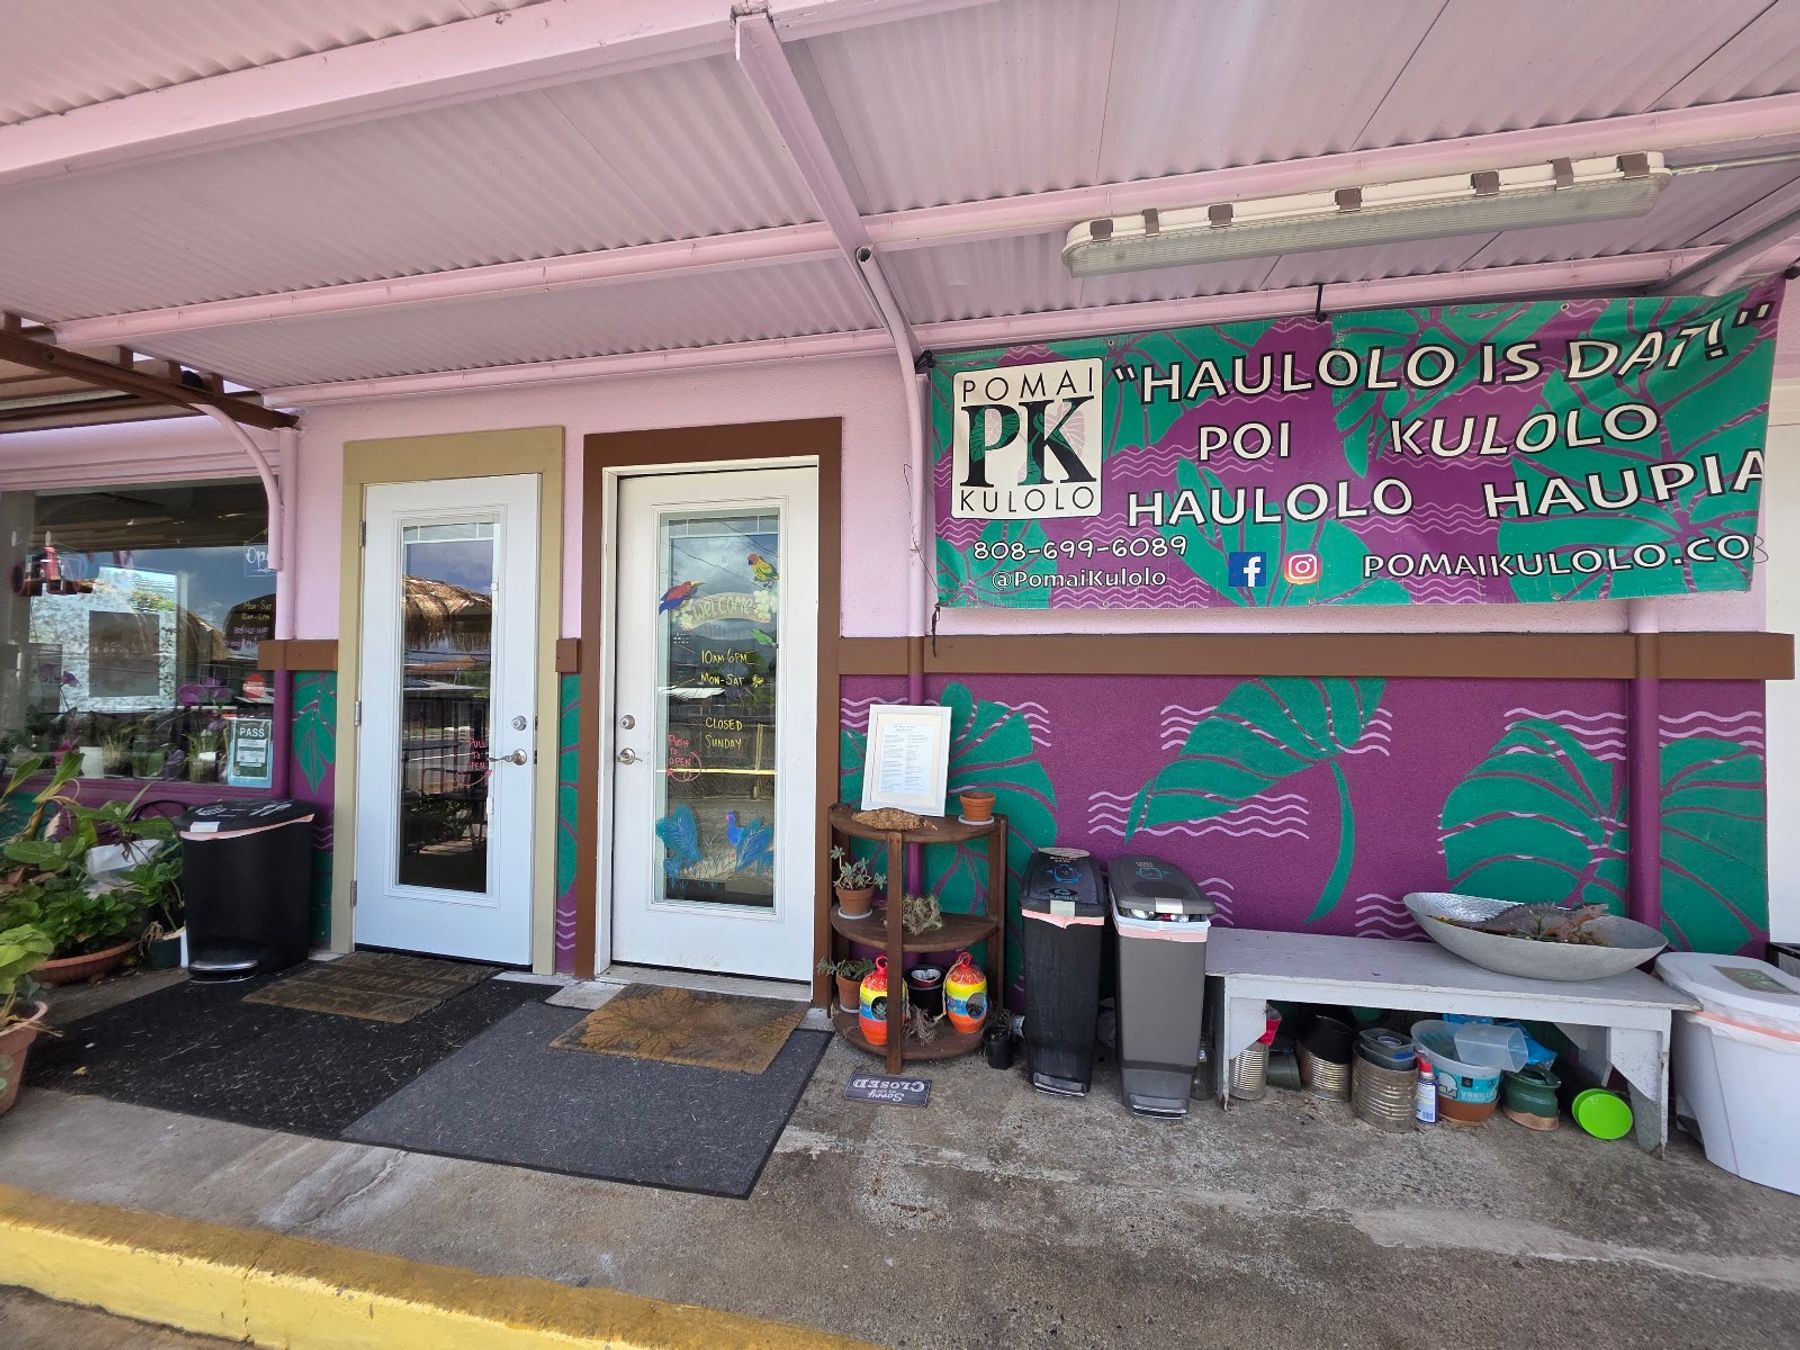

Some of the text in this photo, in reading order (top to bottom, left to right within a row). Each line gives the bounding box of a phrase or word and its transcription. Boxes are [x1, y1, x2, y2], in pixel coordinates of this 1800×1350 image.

[1478, 341, 1542, 386] IS
[961, 366, 1095, 404] POMAI
[959, 395, 1098, 489] PK
[1198, 402, 1660, 462] POI KULOLO
[960, 485, 1096, 514] KULOLO
[1126, 448, 1766, 528] HAULOLO HAUPIA
[245, 546, 269, 568] Op
[973, 534, 1189, 562] 808-699-6089
[1362, 533, 1755, 580] POMAIKULOLO.CO
[991, 568, 1168, 592] @PomaiKulolo
[239, 727, 265, 738] PASS
[705, 716, 743, 732] CLOSED
[668, 734, 690, 748] PUSH
[704, 734, 742, 750] SUNDAY
[668, 757, 692, 767] OPEN
[852, 1079, 925, 1093] CLOSED
[867, 1089, 905, 1102] Sorry
